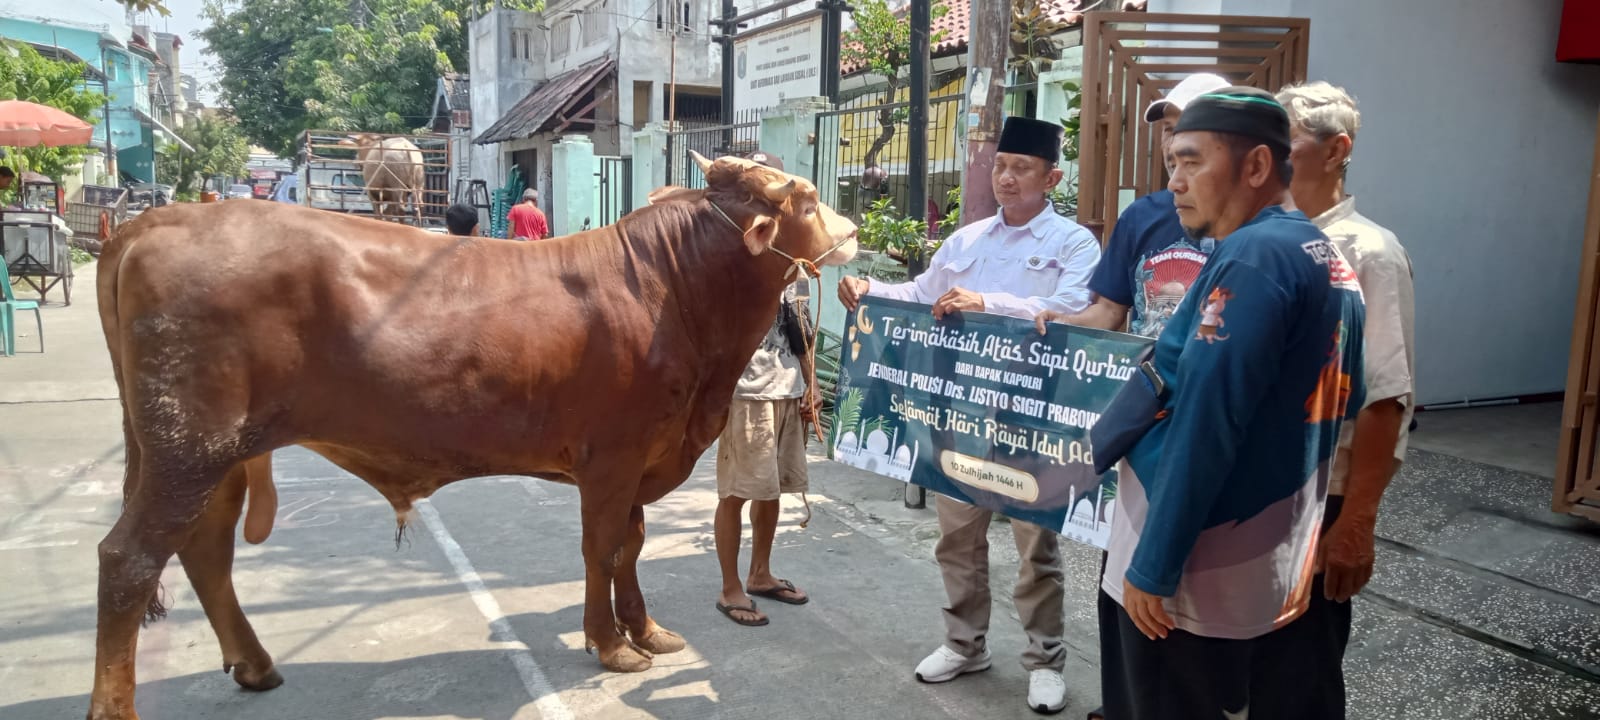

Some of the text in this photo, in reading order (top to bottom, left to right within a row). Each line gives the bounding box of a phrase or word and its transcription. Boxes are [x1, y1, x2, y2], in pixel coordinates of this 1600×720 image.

[1150, 252, 1172, 265] TEAM
[955, 361, 1043, 391] DARI BAPAK KAPOLRI
[867, 361, 1101, 431] JENDERAL POLISI Drs. LISTYO SIGIT PRABOW
[951, 461, 1023, 490] 10 Zulhijah 1446 H
